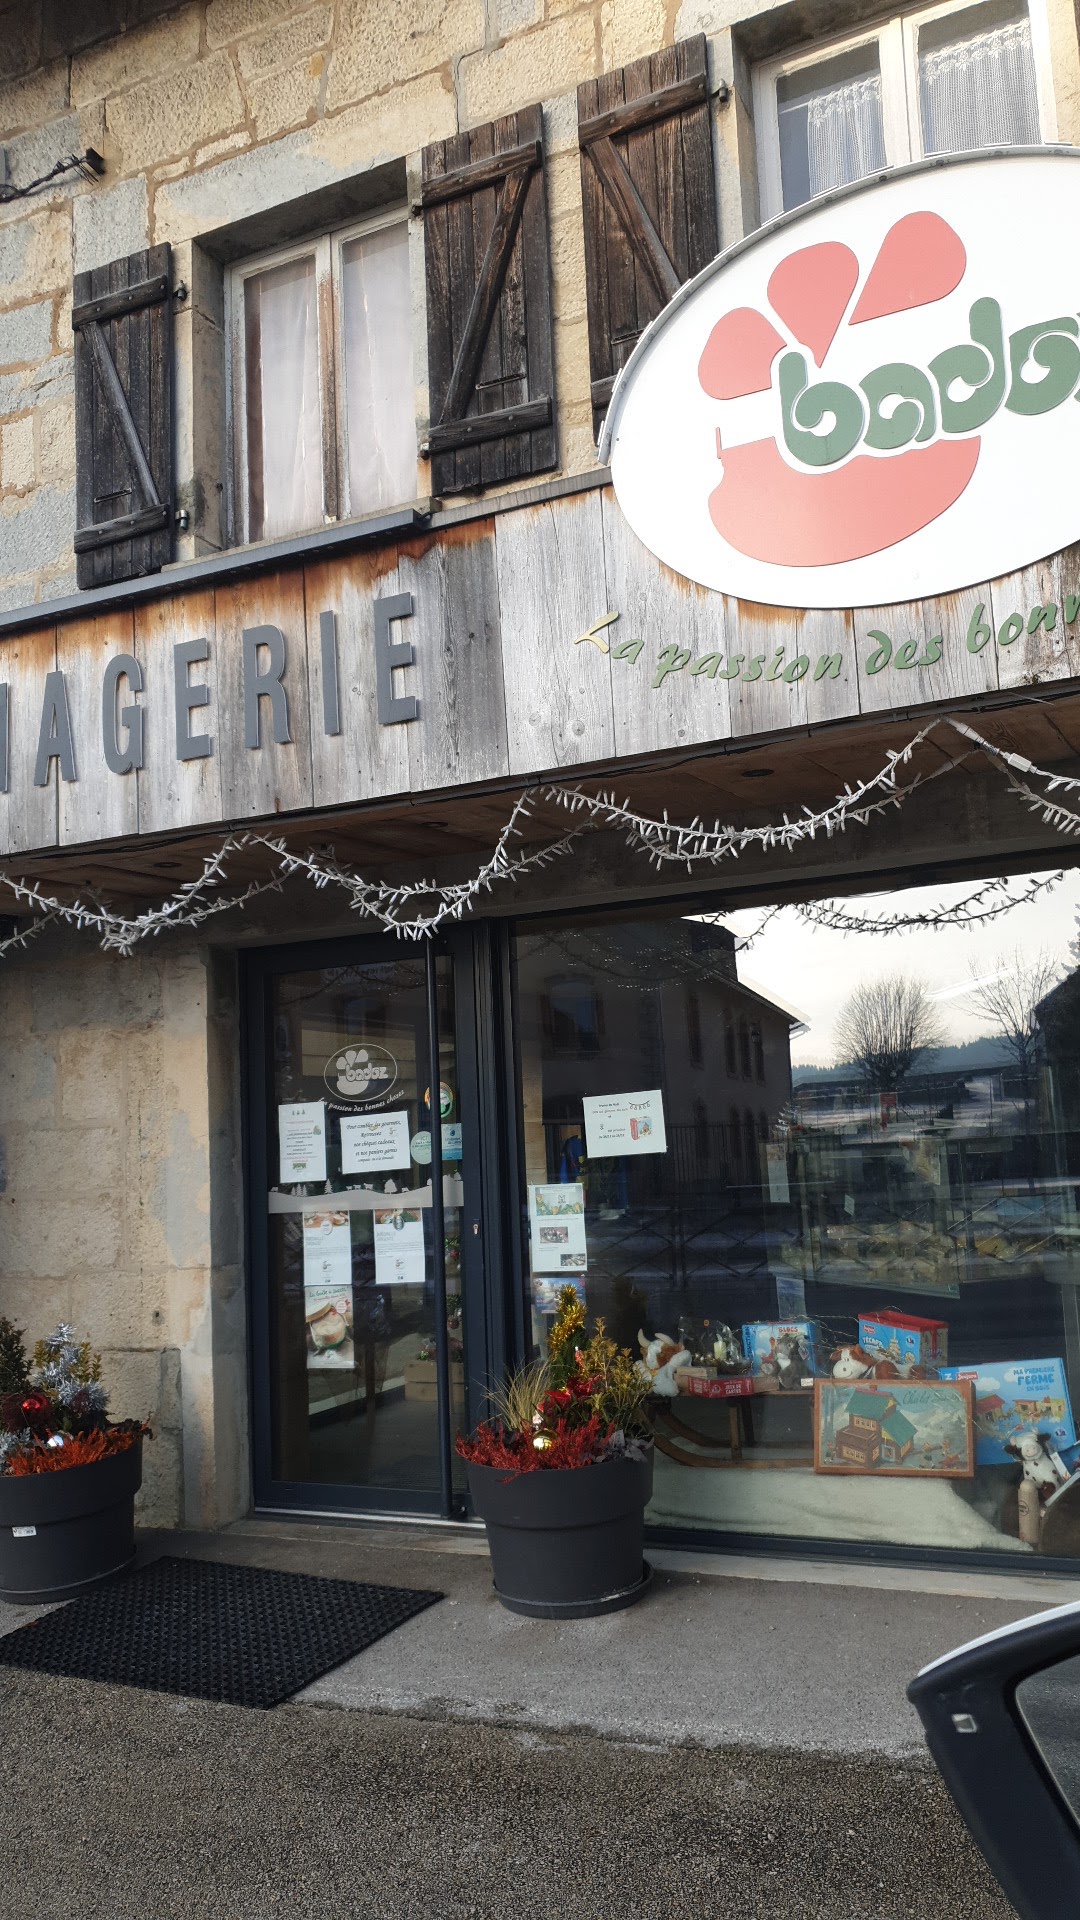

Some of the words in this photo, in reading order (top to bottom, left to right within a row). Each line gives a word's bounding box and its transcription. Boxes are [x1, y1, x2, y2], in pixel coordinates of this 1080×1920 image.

[778, 296, 1080, 466] bado
[652, 643, 843, 688] passion
[865, 629, 944, 675] des
[327, 1103, 352, 1112] passion
[353, 1104, 364, 1112] des
[364, 1101, 385, 1111] bonnes
[1017, 1373, 1054, 1386] FERME
